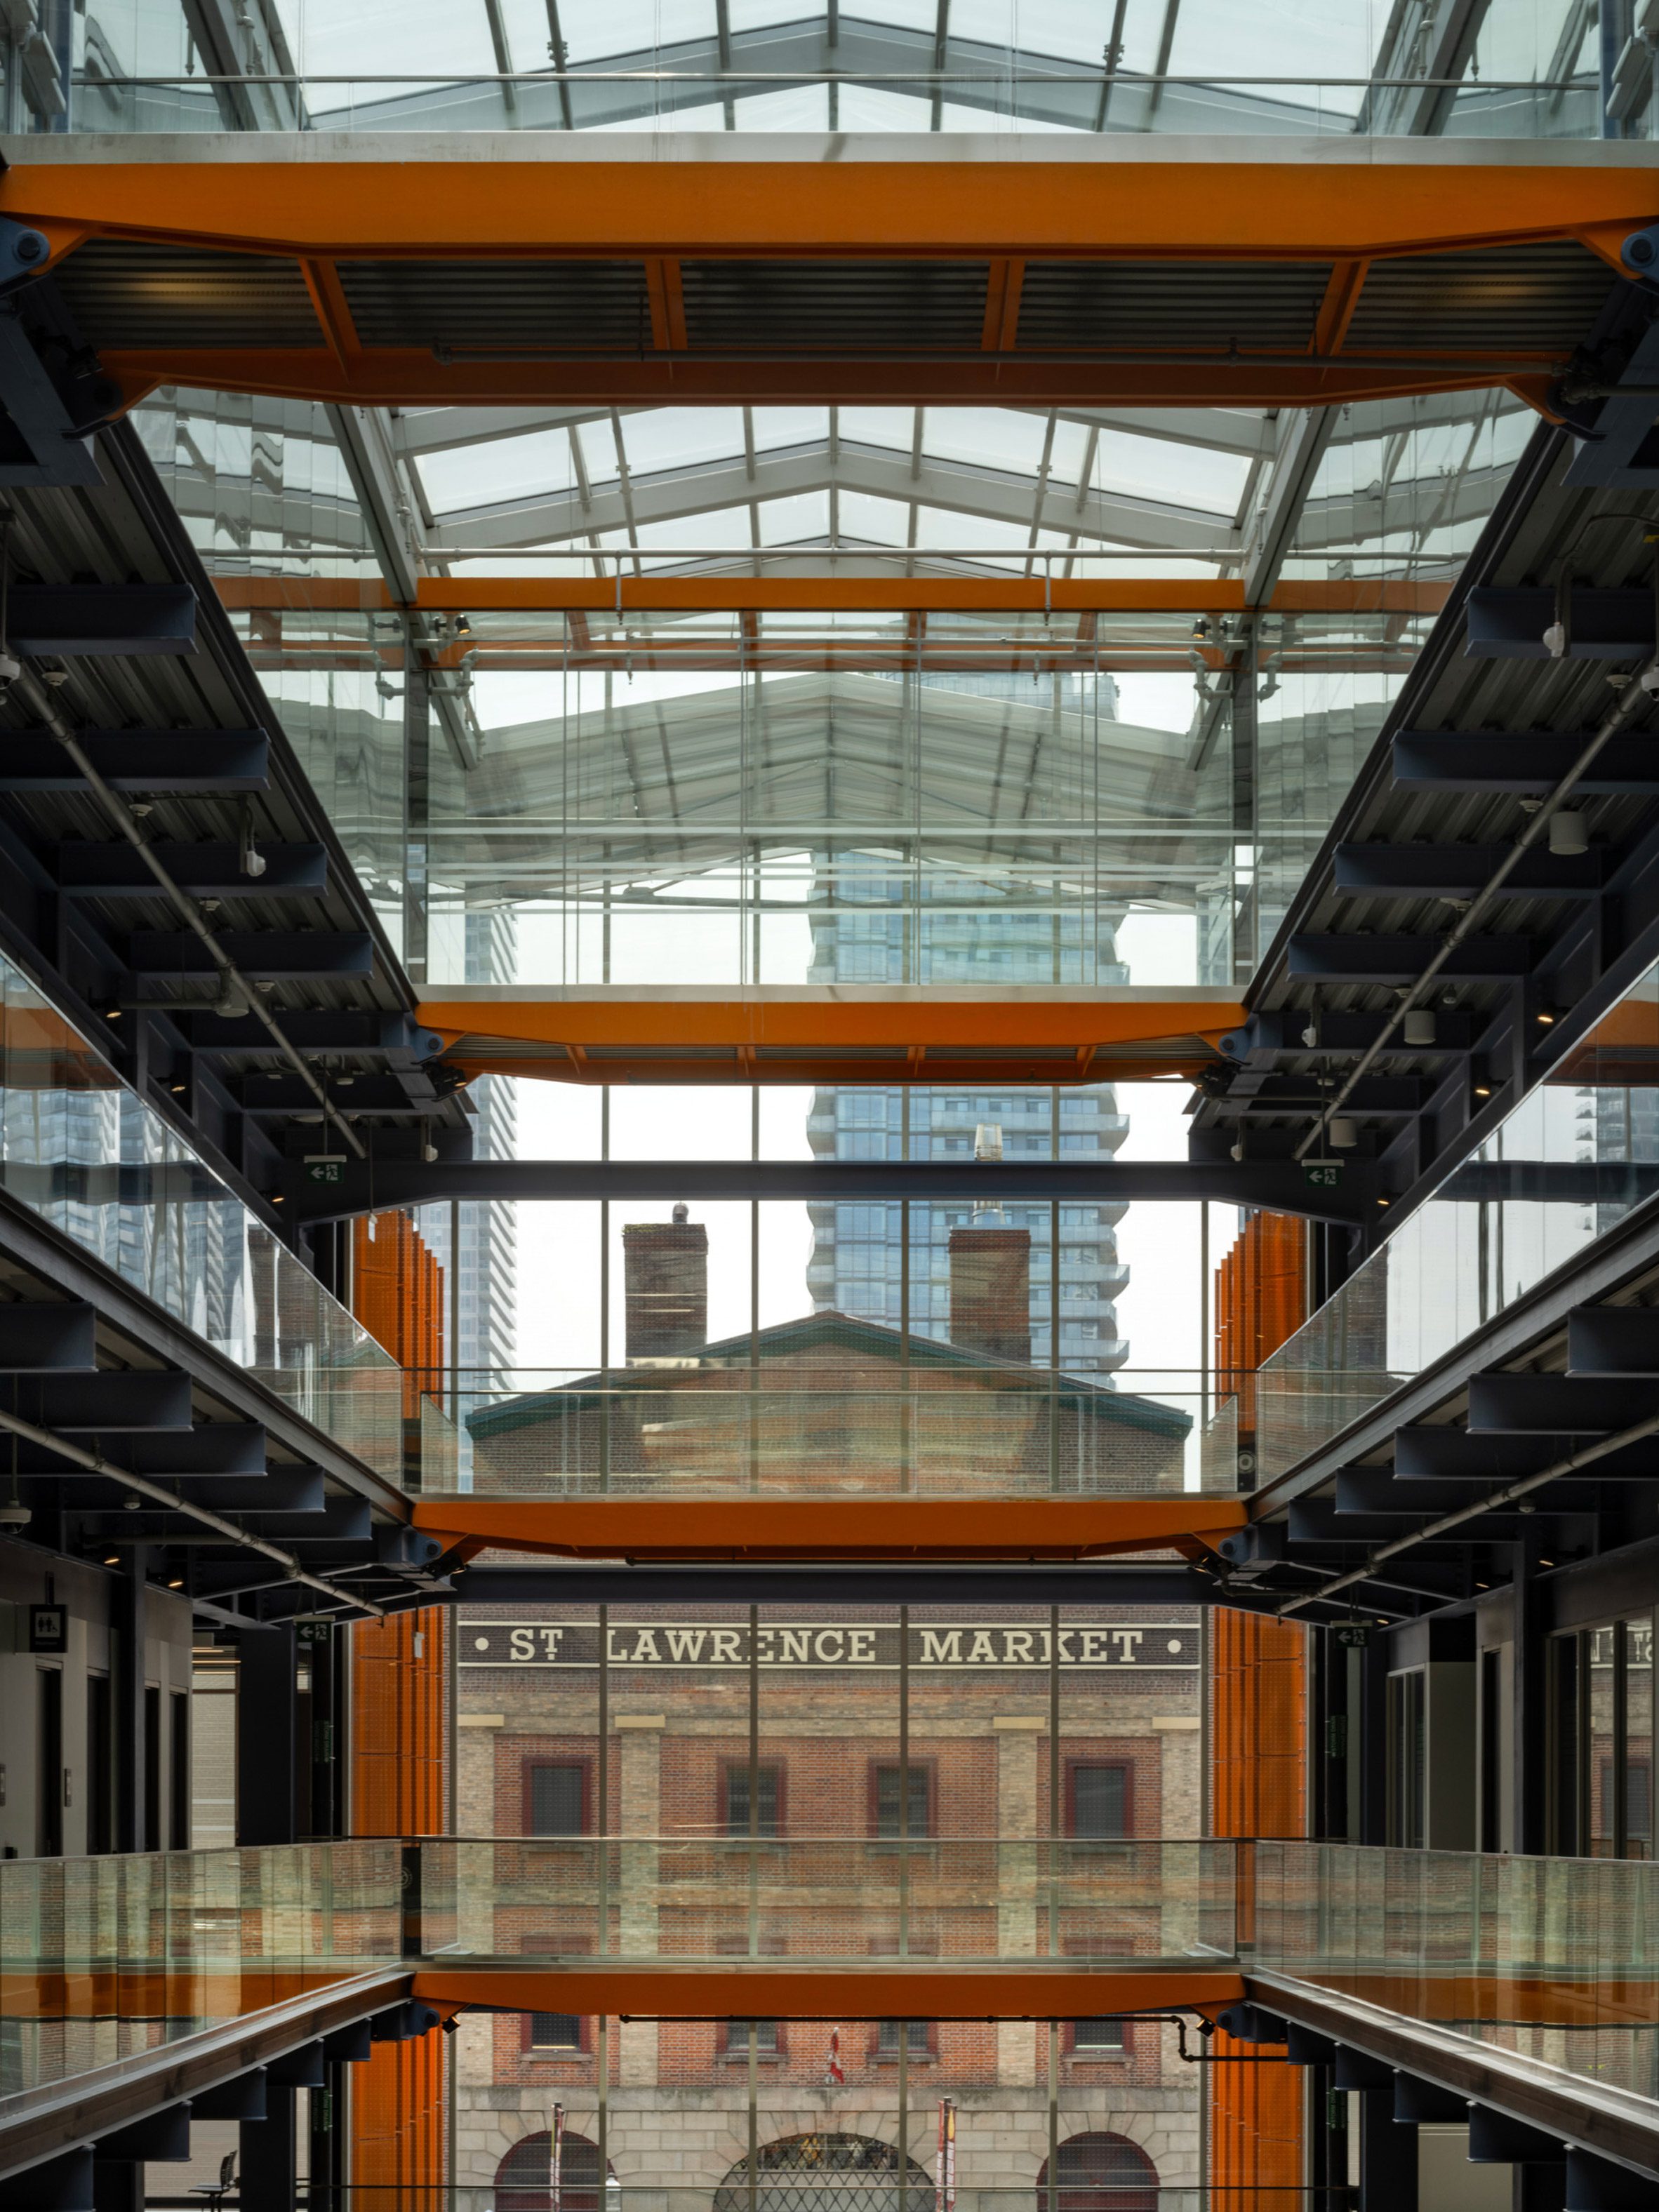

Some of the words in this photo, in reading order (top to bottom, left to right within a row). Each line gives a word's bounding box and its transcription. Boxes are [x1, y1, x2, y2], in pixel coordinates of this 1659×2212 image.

[509, 1628, 563, 1661] ST
[607, 1630, 876, 1663] LAWRENCE
[919, 1630, 1143, 1663] MARKET
